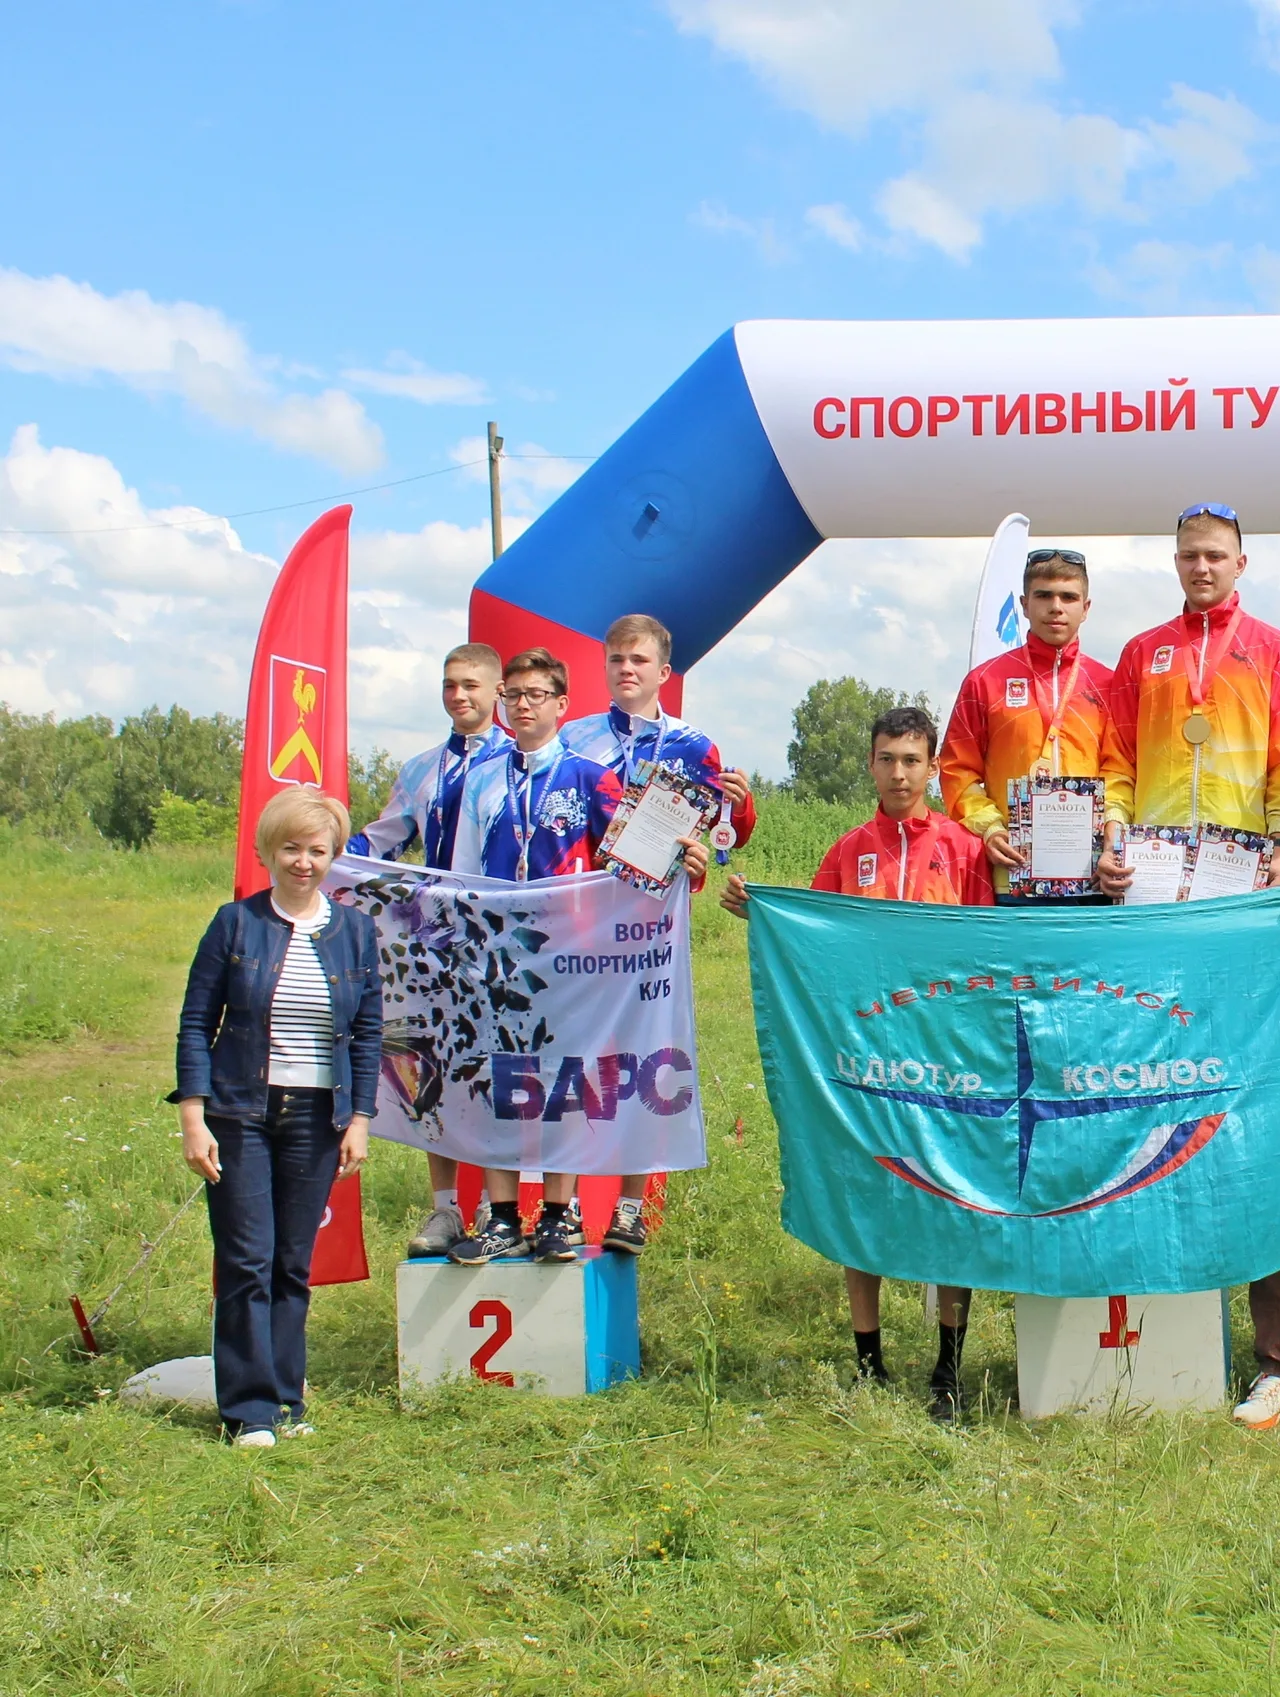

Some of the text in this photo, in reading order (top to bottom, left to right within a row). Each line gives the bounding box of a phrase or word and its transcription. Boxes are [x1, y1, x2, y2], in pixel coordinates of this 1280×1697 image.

[813, 377, 1196, 439] СПОРТИВНЫЙ
[649, 793, 692, 824] ГРАМОТА
[1039, 803, 1087, 812] ГРАМОТА
[1131, 851, 1180, 861] ГРАМОТА
[1204, 850, 1251, 868] ГРАМОТА
[855, 974, 1196, 1027] ЧЕЛЯБИНСК
[490, 1047, 694, 1122] БАРС
[1062, 1056, 1225, 1093] КОСМОС
[469, 1300, 515, 1387] 2
